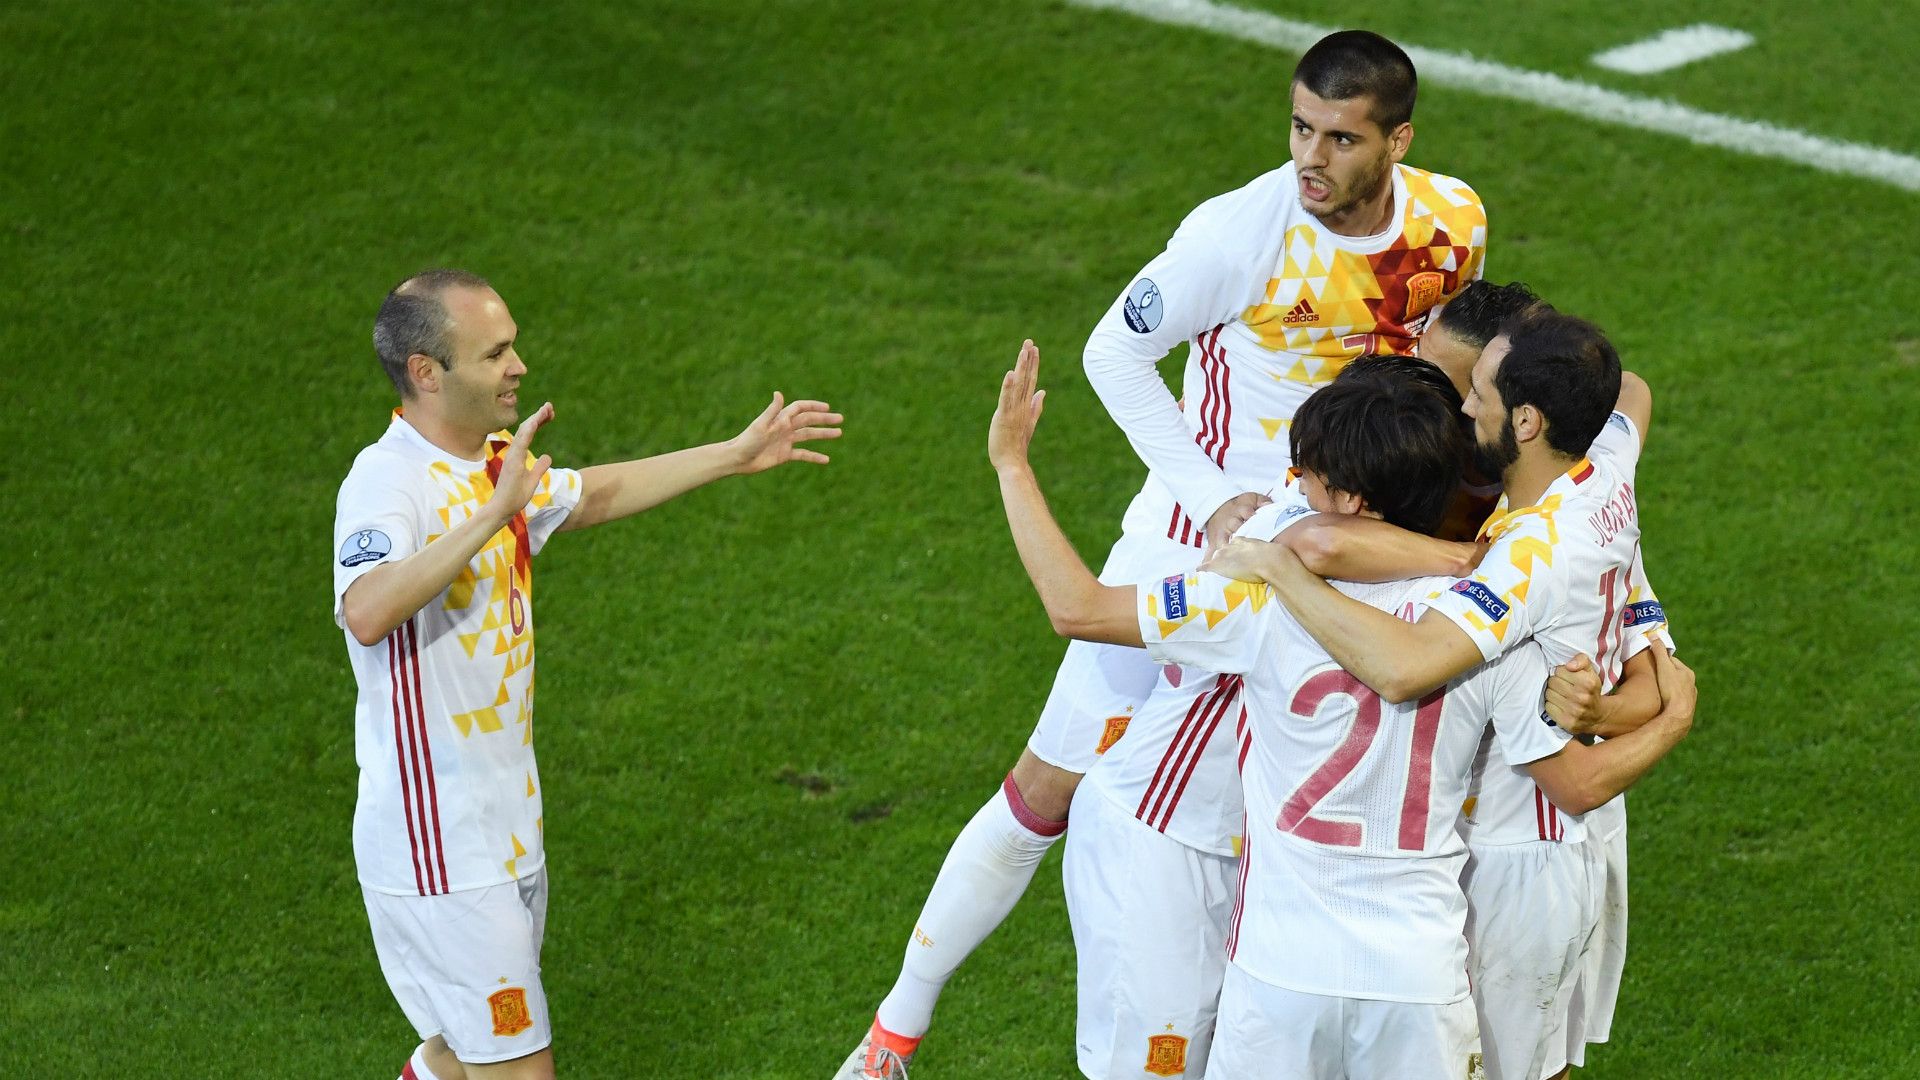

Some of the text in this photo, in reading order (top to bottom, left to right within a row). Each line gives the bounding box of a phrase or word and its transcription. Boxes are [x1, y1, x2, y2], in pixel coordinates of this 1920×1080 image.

[1282, 313, 1320, 323] adidas
[508, 564, 525, 637] 6
[1466, 585, 1506, 617] RESPECT
[1275, 666, 1449, 852] 21
